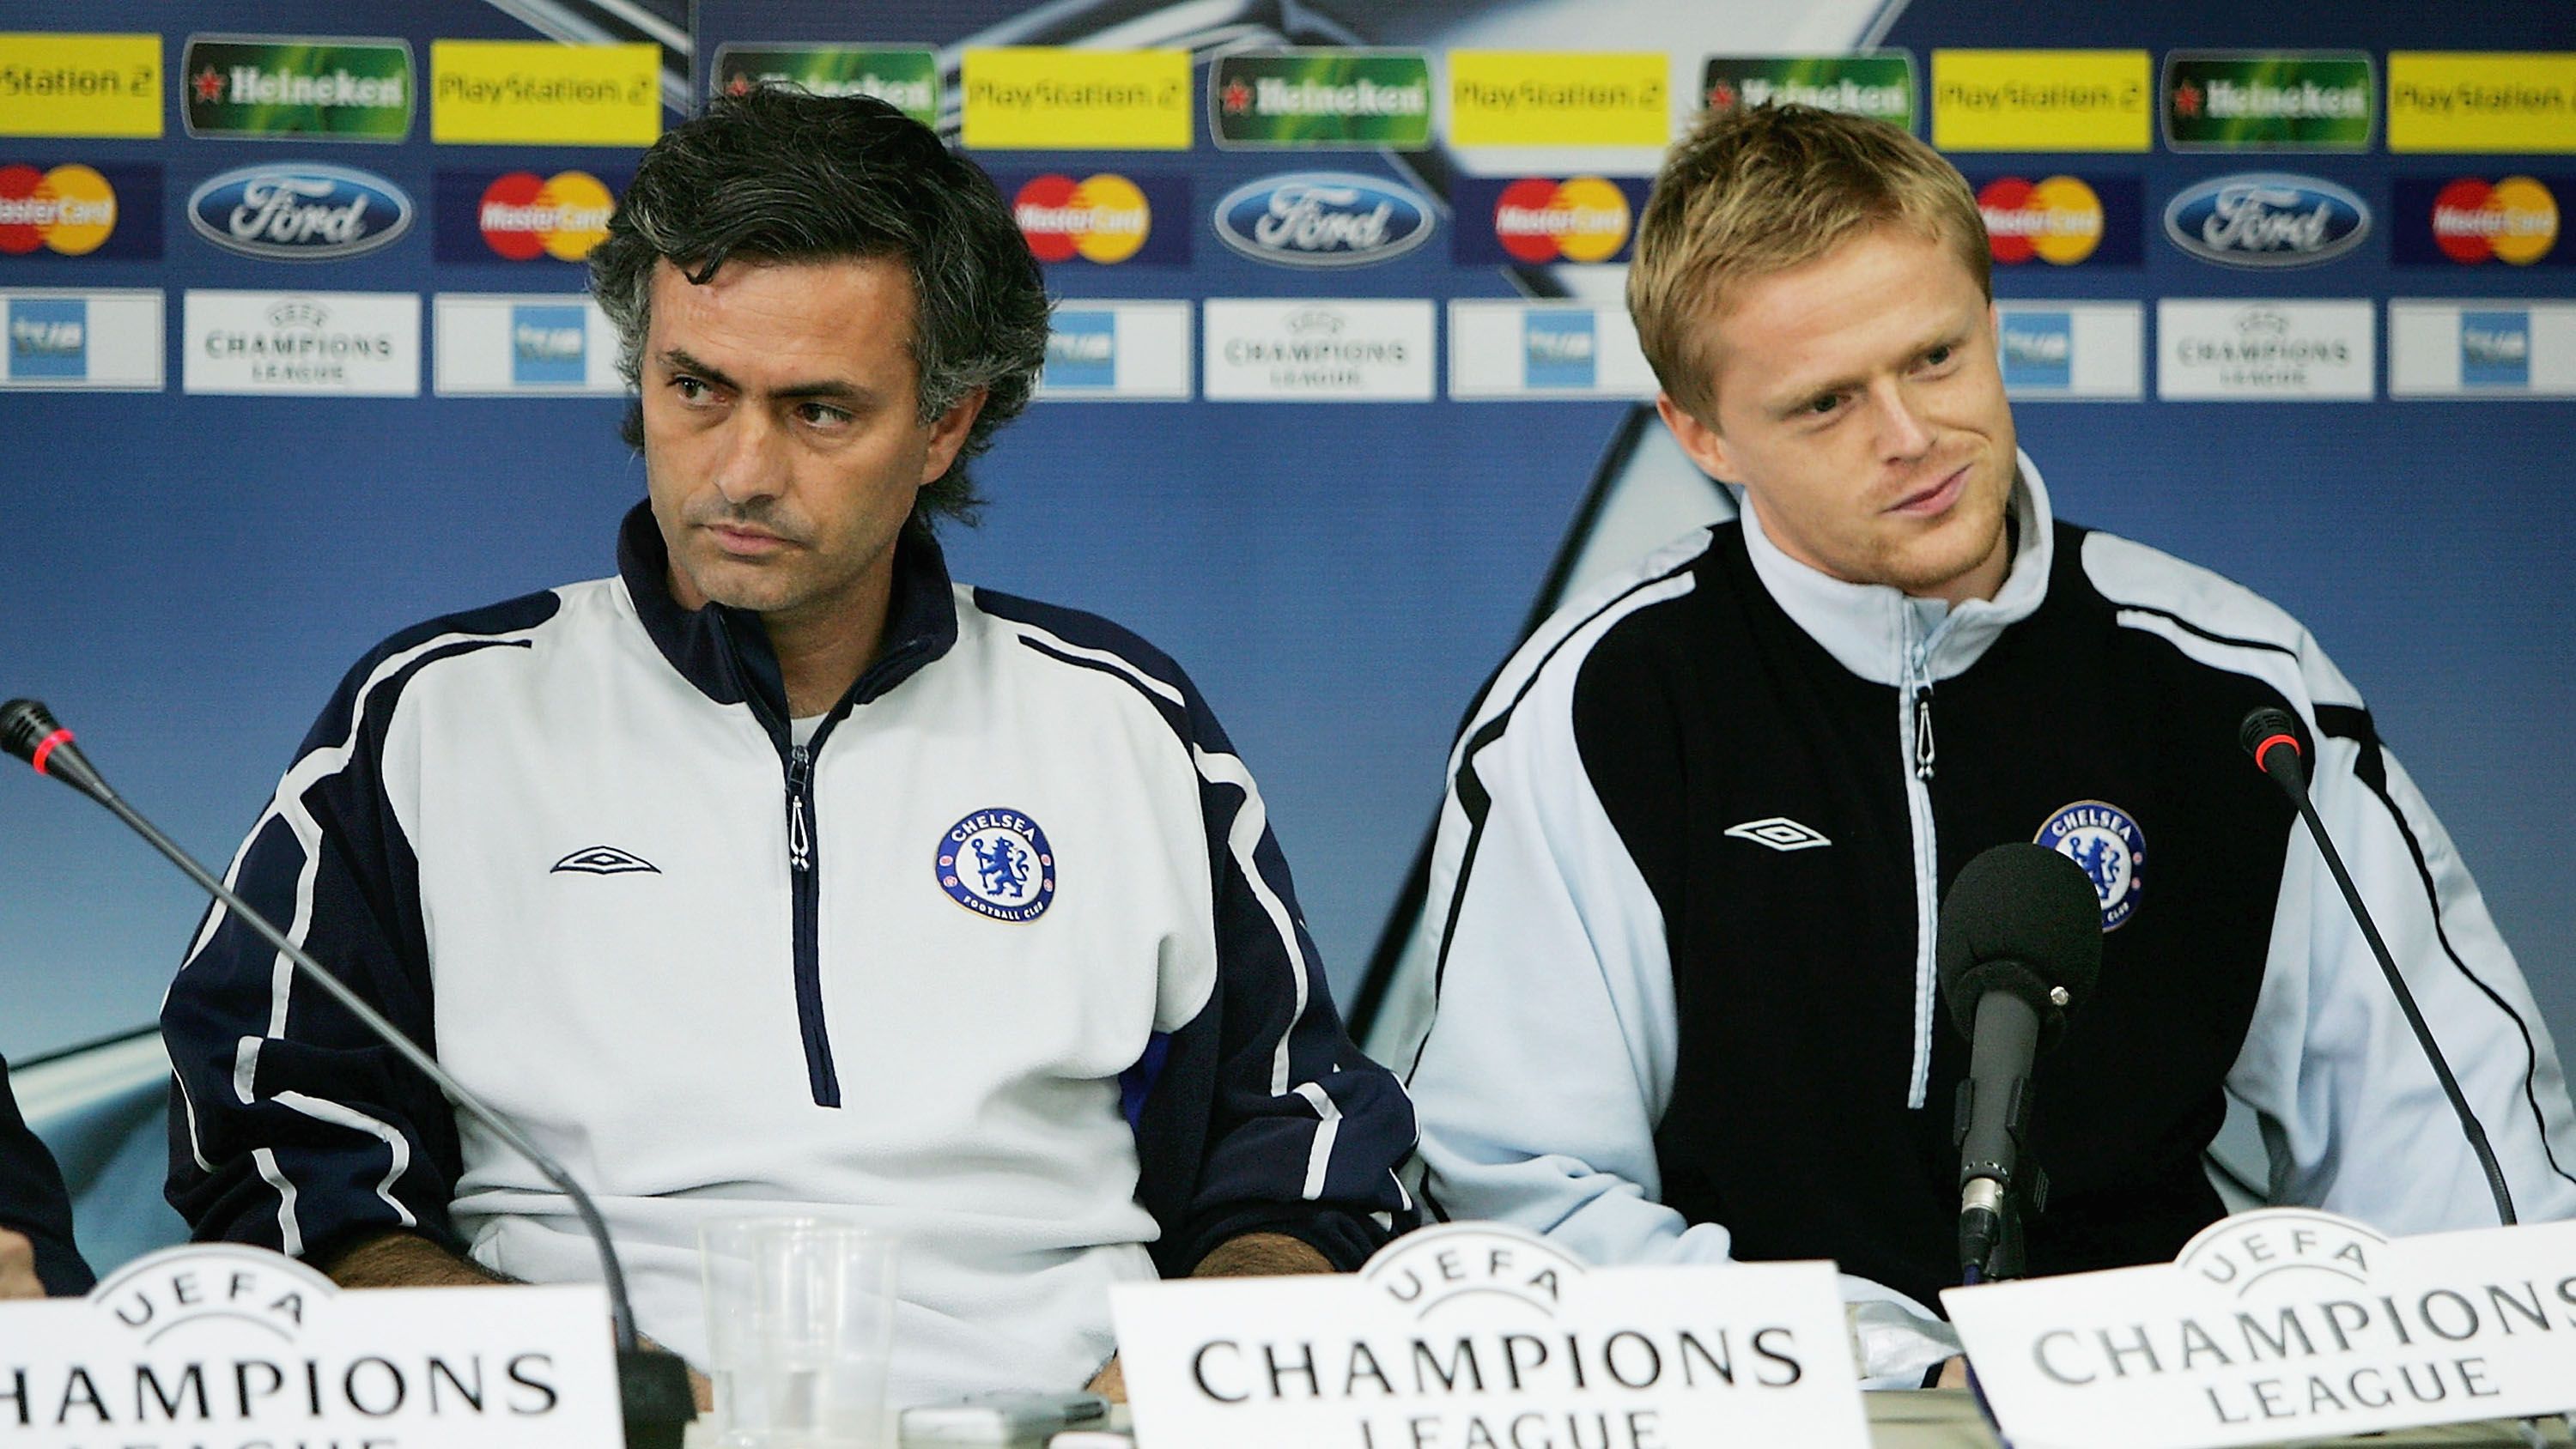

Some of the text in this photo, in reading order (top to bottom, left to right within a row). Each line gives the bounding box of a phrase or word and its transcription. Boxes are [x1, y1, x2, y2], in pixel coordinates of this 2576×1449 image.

[2, 64, 152, 97] Station 2
[229, 66, 409, 106] Heineken
[439, 73, 650, 106] PlayStation 2
[969, 78, 1152, 112] PlayStation
[1256, 77, 1427, 116] Heineken
[1455, 79, 1633, 114] PlayStation
[1939, 79, 2114, 115] PlayStation
[2207, 80, 2367, 118] Heineken
[0, 197, 114, 226] asterCard
[228, 178, 369, 243] Ford
[1015, 204, 1142, 234] MasterCard
[1255, 185, 1393, 248] Ford
[1496, 205, 1622, 235] MasterCard
[2202, 185, 2331, 249] Ford
[2433, 205, 2555, 236] MasterCard
[205, 329, 392, 361] CHAMPIONS
[1225, 337, 1409, 367] CHAMPIONS
[2178, 337, 2350, 367] CHAMPIONS
[252, 361, 346, 383] LEAGUE
[951, 814, 1036, 842] CHELSEA
[2051, 809, 2131, 841] CHELSEA
[963, 895, 1043, 920] FOOTBALL CLUB
[2202, 1228, 2368, 1284] UEFA
[1388, 1248, 1560, 1304] UEFA
[116, 1270, 304, 1328] UEFA
[1190, 1327, 1803, 1403] CHAMPIONS
[0, 1354, 560, 1425] HAMPIONS
[2204, 1356, 2501, 1425] LEAGUE
